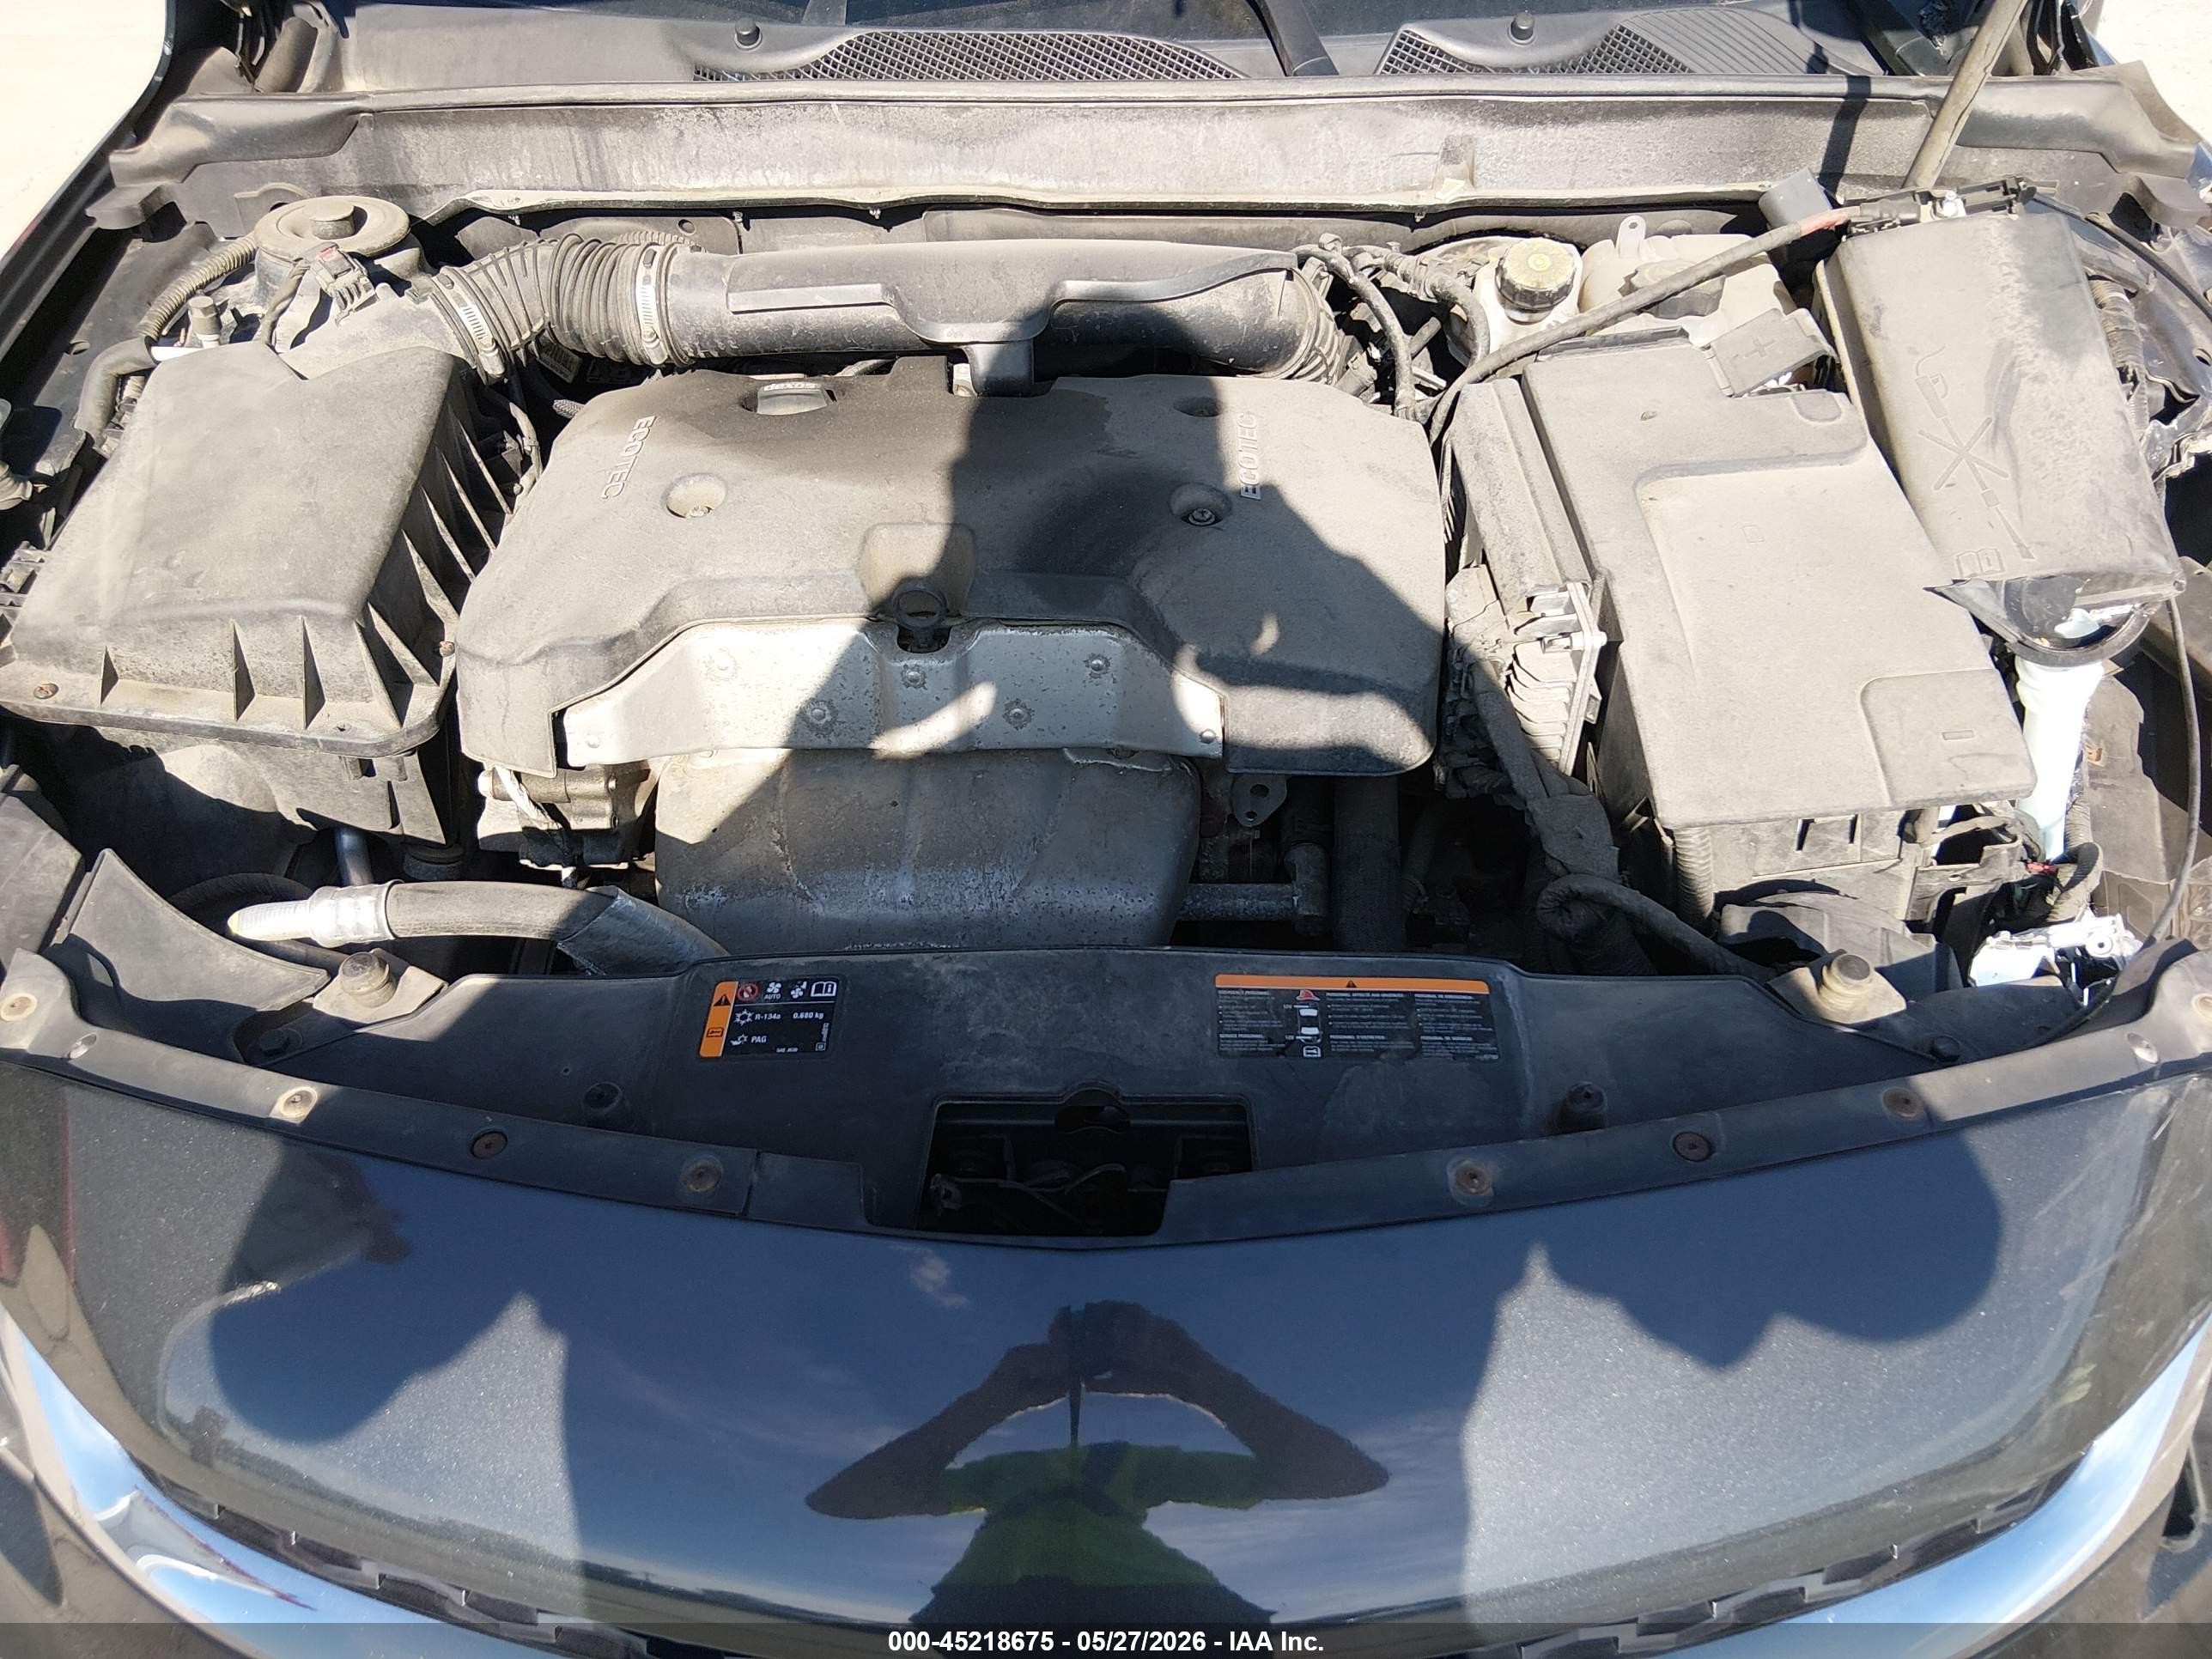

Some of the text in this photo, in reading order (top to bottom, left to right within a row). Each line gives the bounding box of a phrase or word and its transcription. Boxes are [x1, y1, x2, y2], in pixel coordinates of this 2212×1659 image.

[763, 382, 818, 392] dexos
[600, 415, 657, 500] ECOTEC
[1236, 410, 1261, 501] ECOTEC
[815, 1012, 824, 1020] kg
